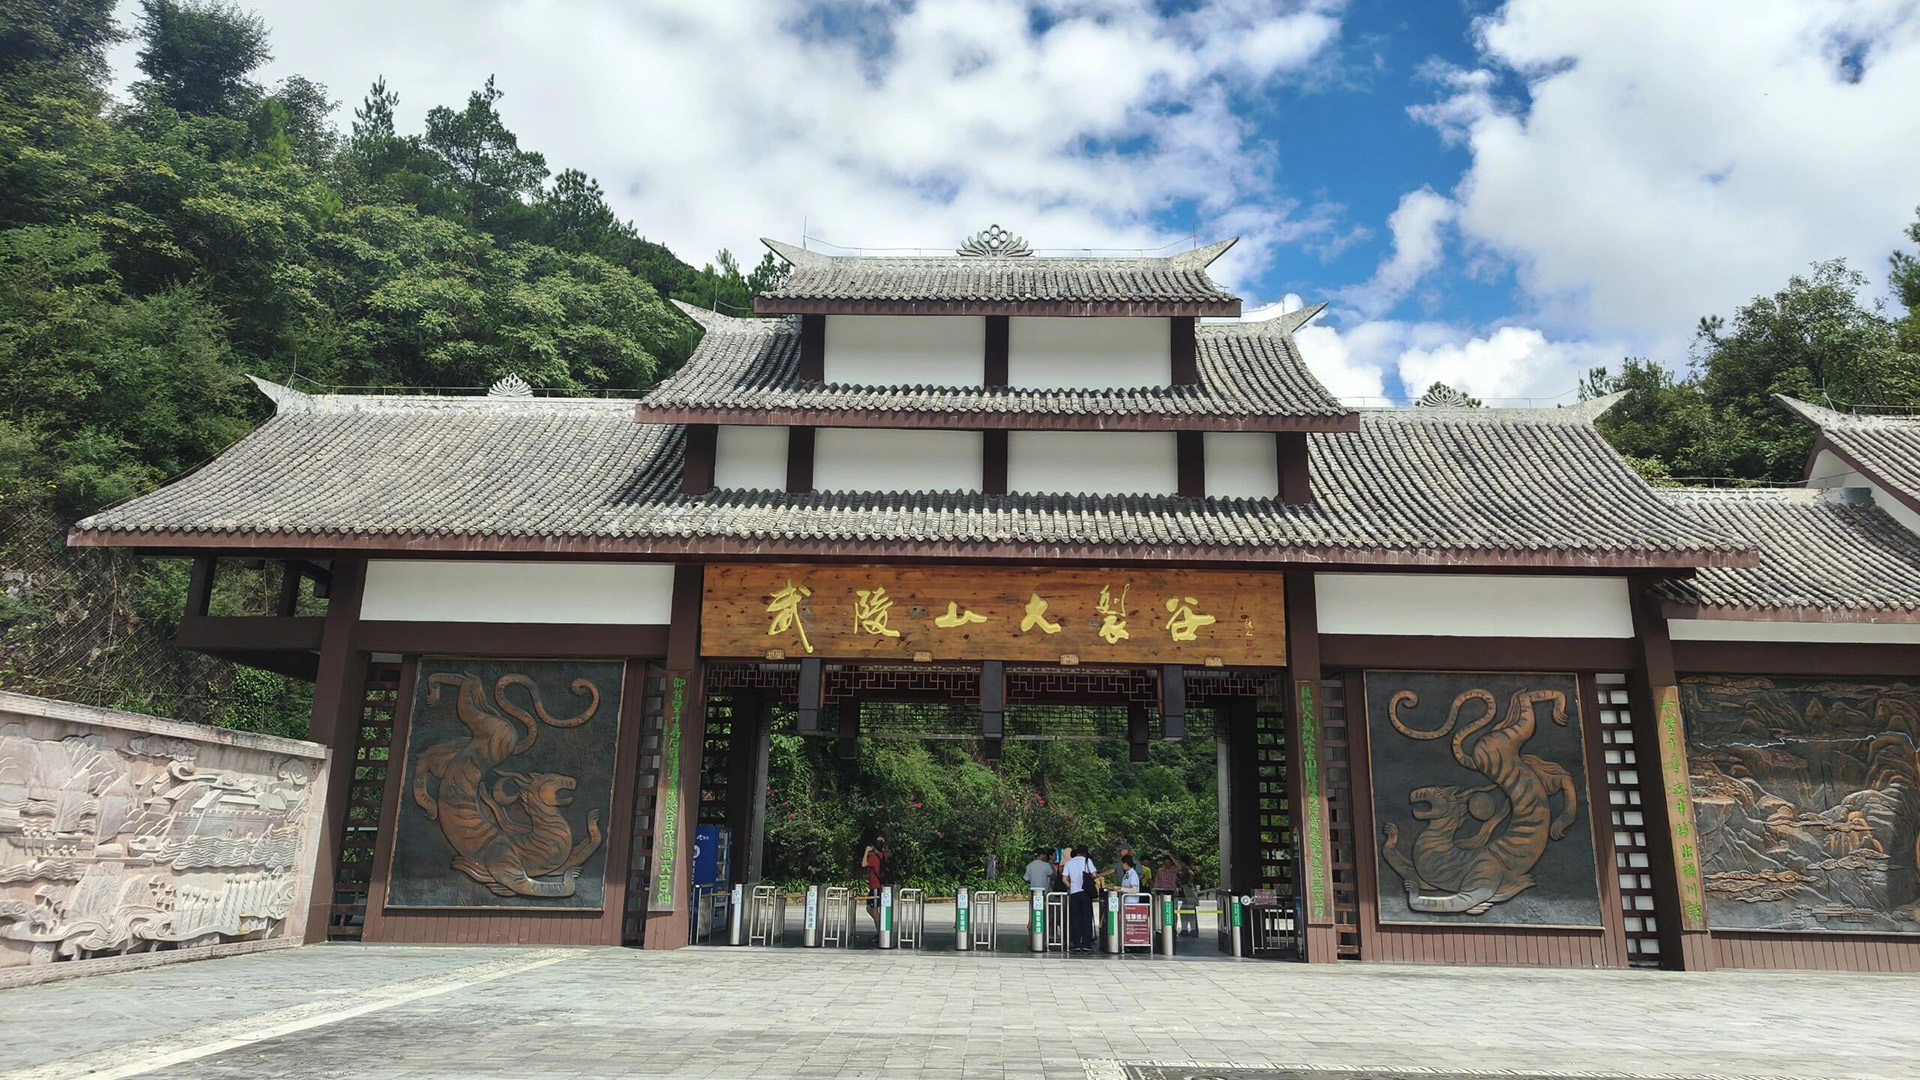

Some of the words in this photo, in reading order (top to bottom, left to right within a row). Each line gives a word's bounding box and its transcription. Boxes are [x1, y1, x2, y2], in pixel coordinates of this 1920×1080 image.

[766, 579, 1217, 654] 武陵山大裂谷
